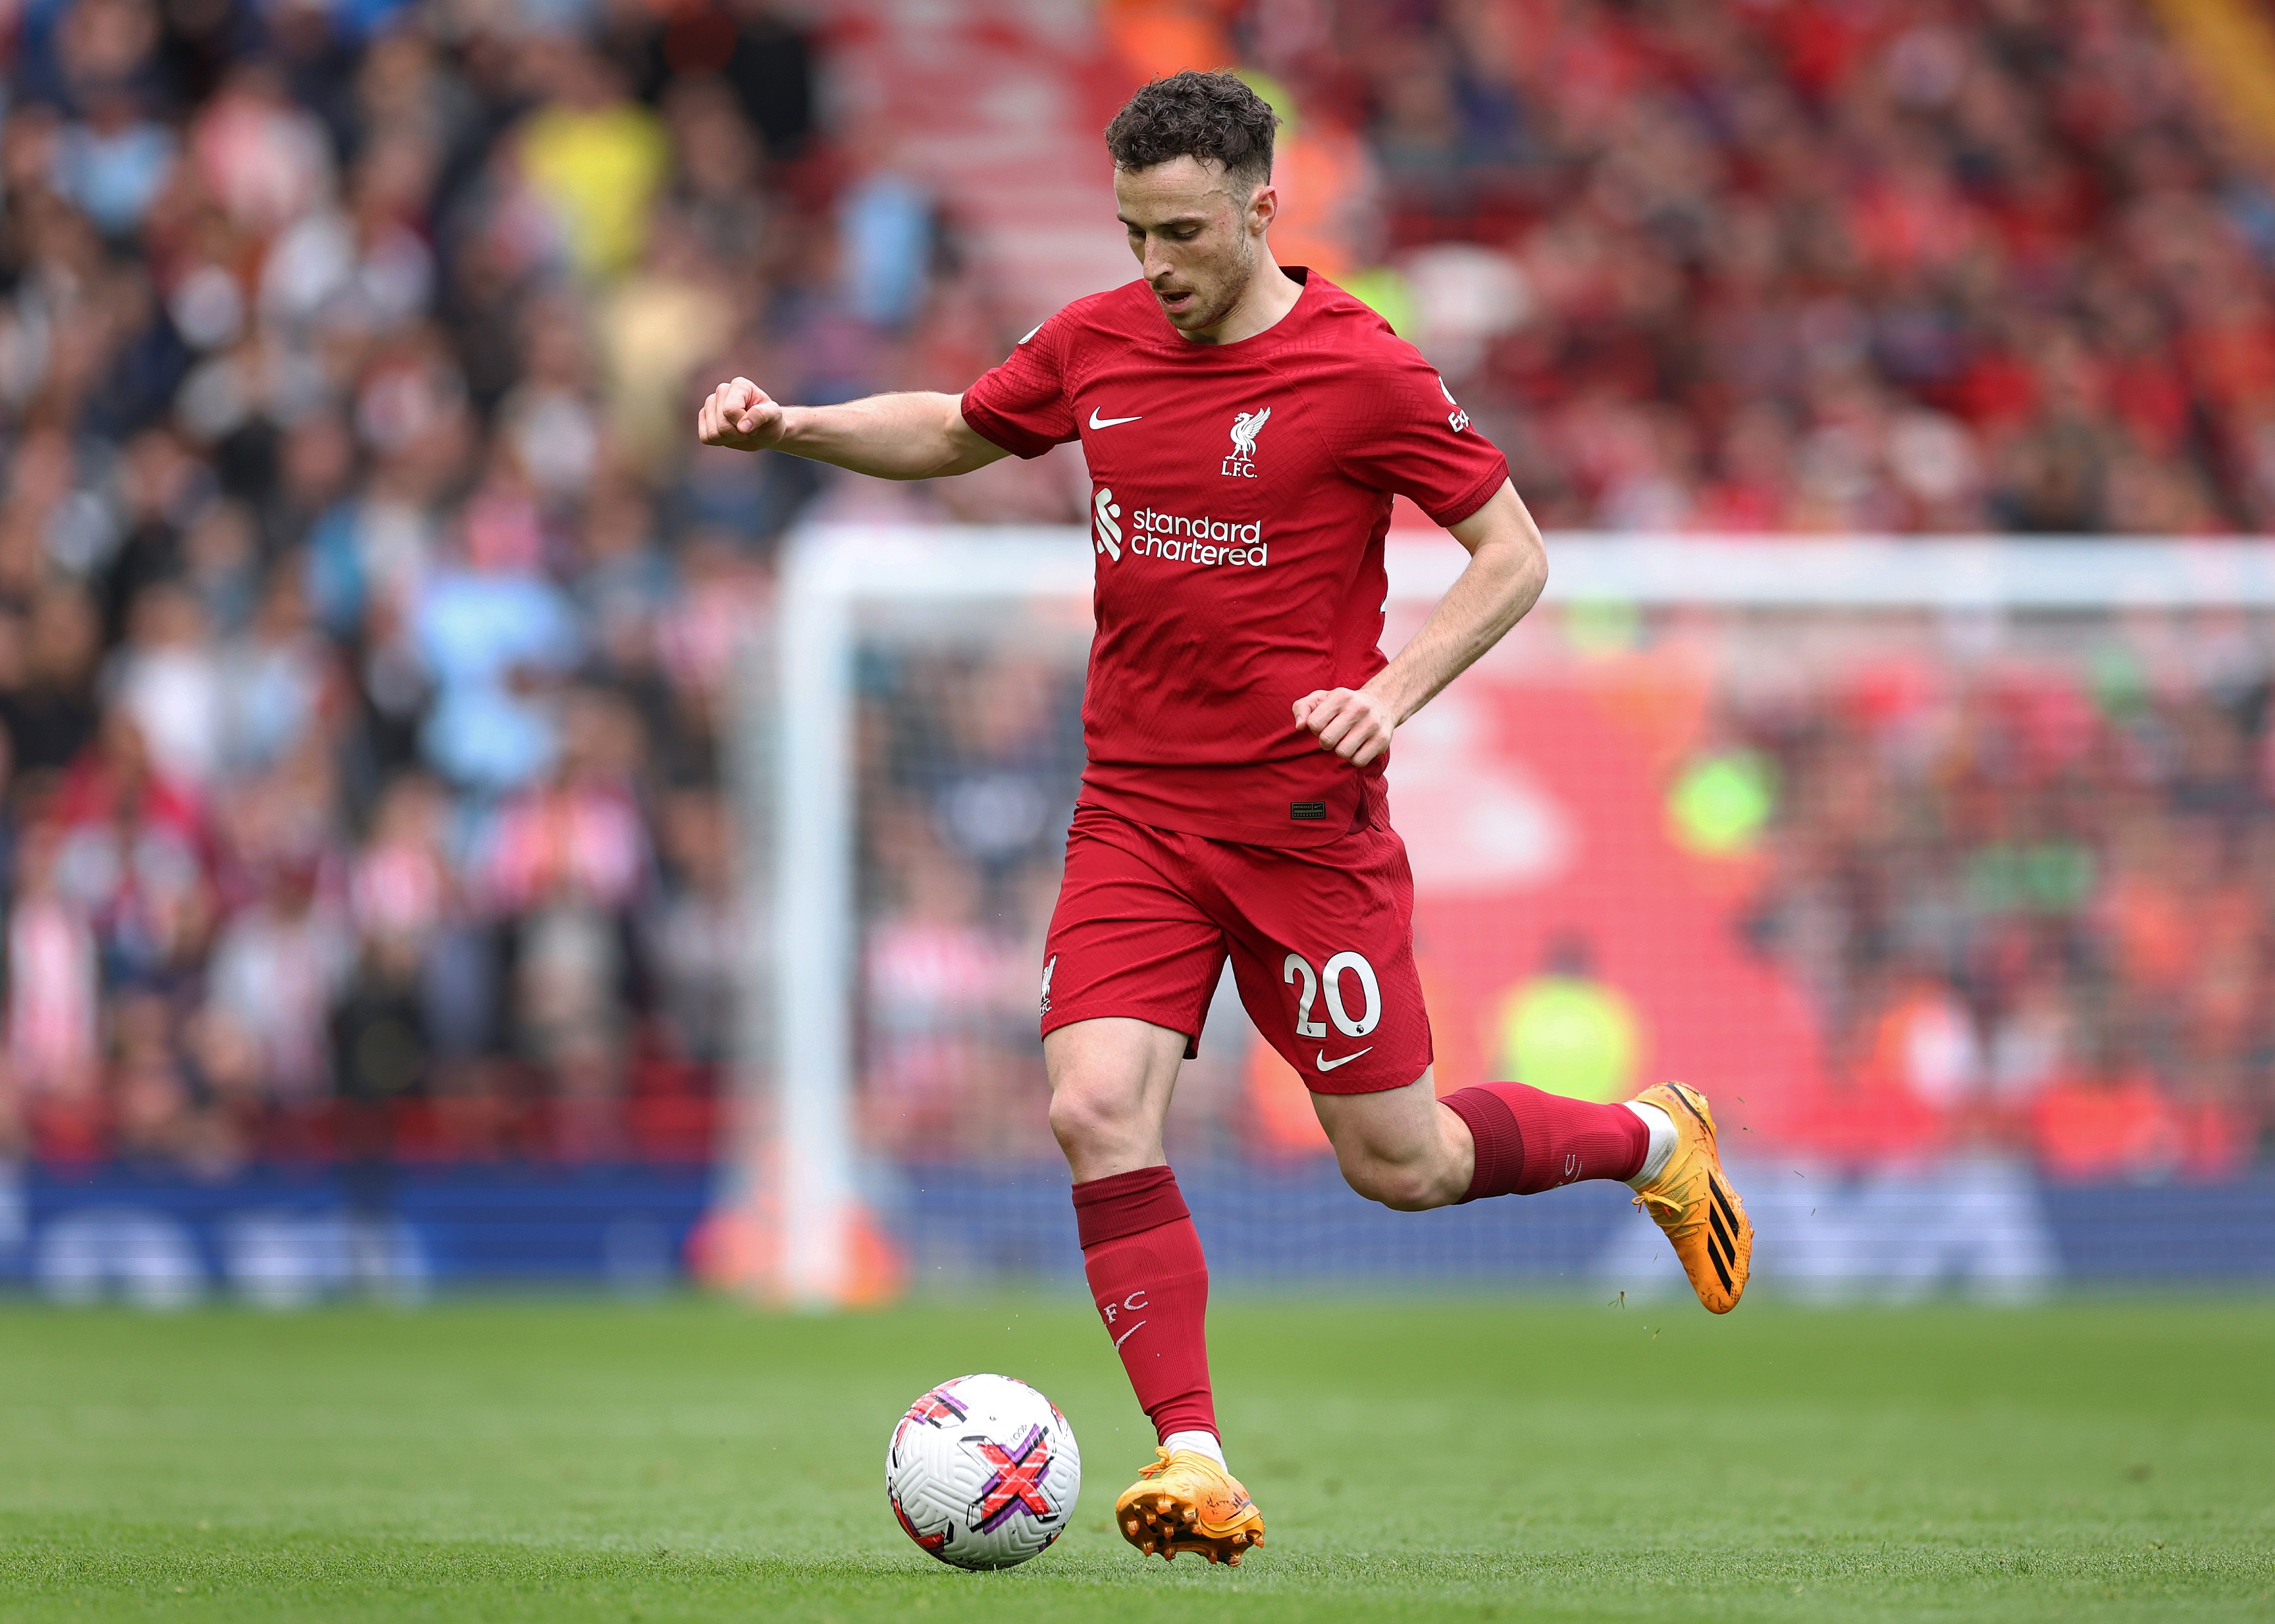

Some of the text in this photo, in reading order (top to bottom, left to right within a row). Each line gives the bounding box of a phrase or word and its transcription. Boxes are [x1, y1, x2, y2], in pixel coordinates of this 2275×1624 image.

[1221, 460, 1258, 478] L.F.C.
[1133, 507, 1261, 544] standard
[1131, 532, 1268, 566] chartered
[1284, 951, 1382, 1038] 20
